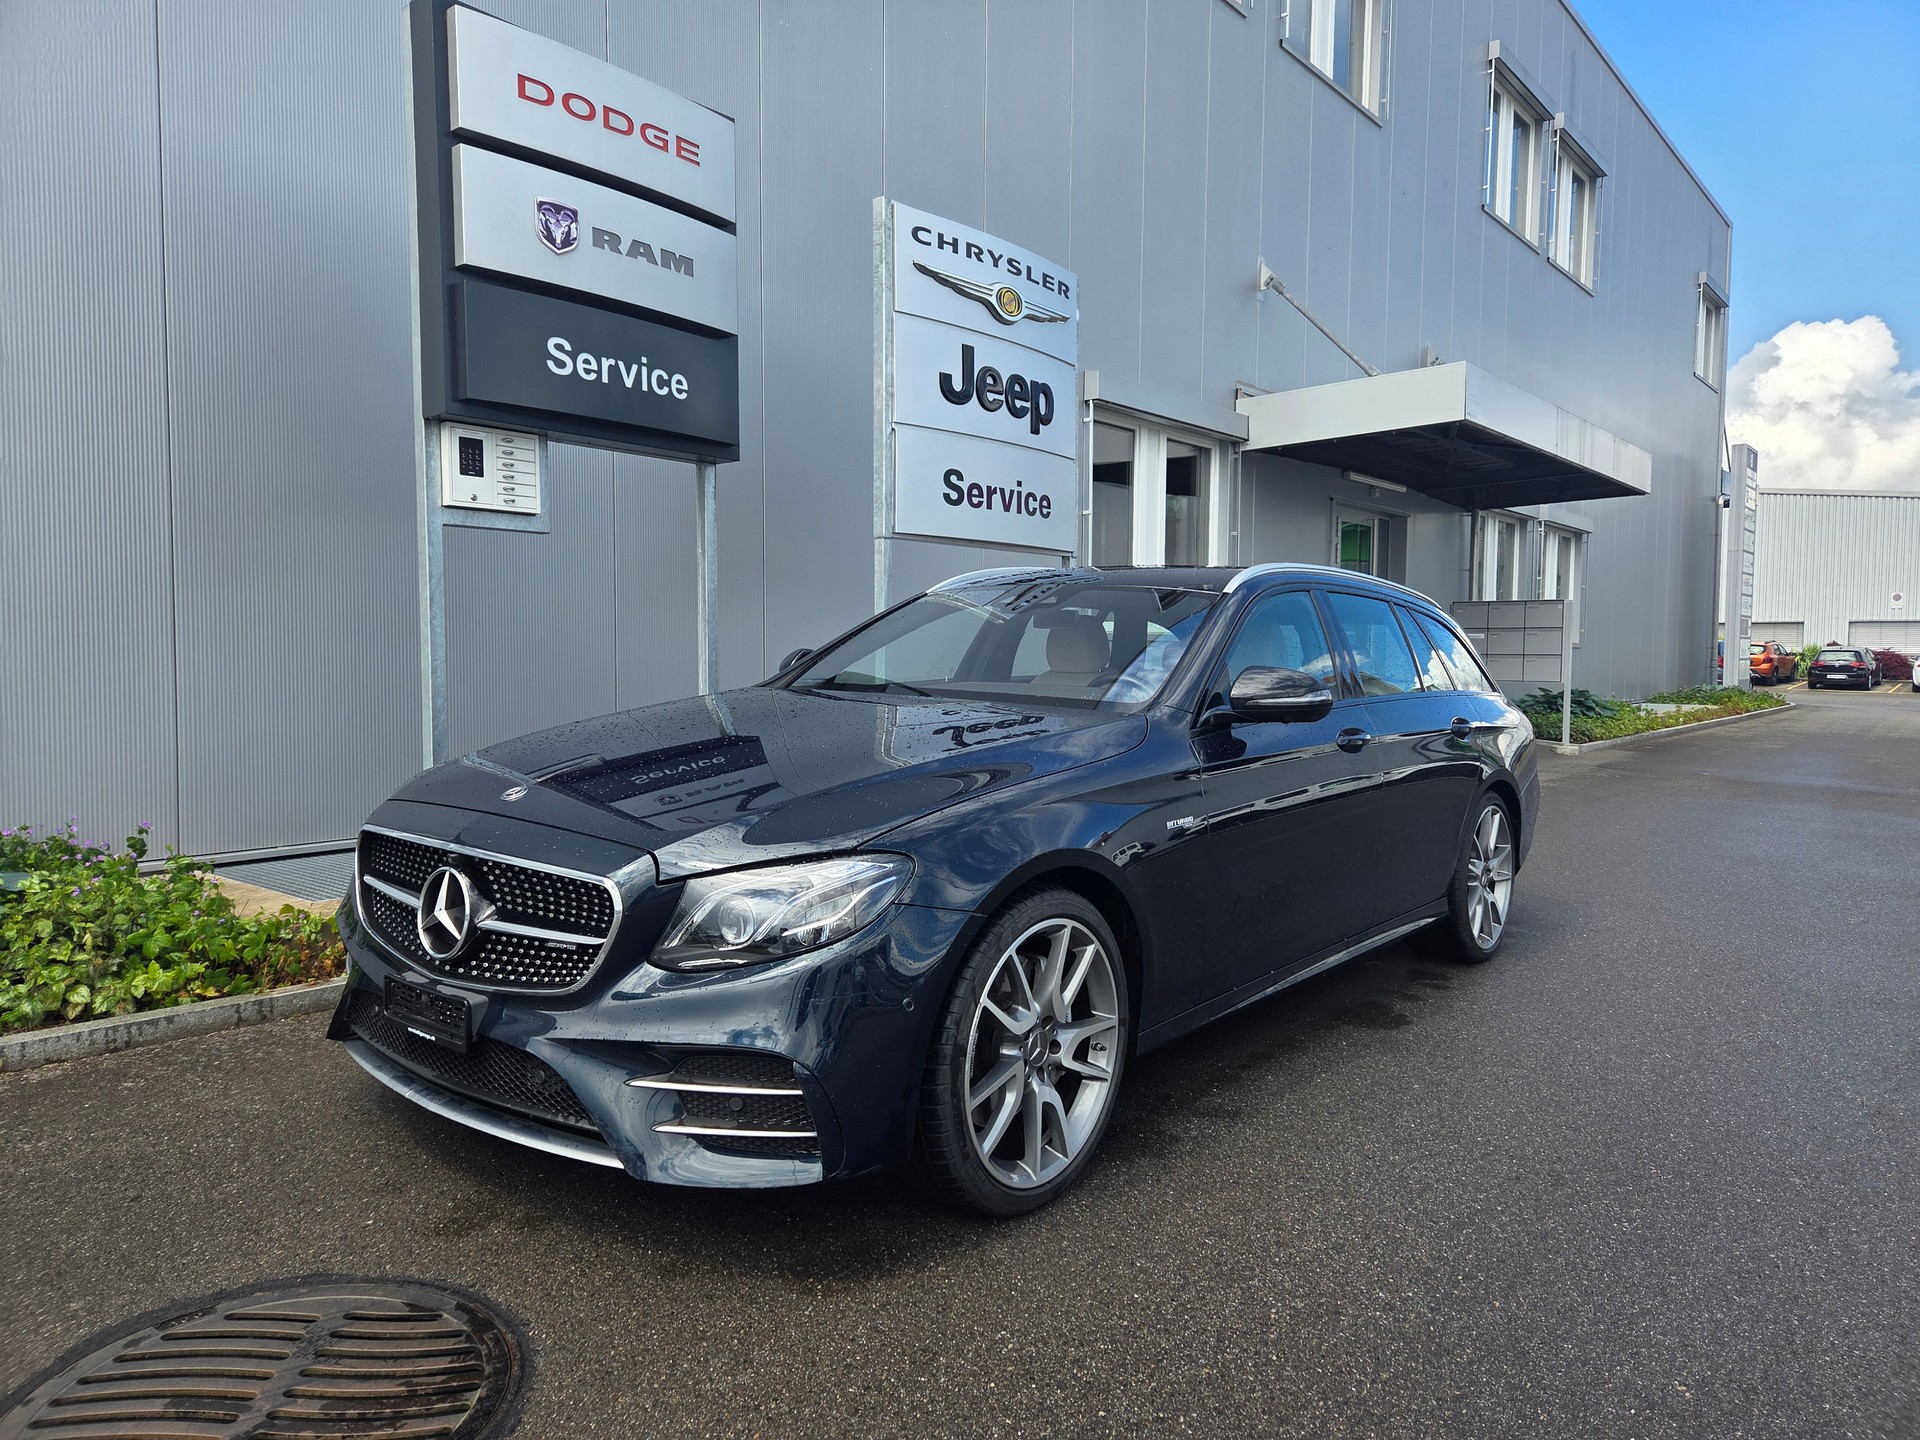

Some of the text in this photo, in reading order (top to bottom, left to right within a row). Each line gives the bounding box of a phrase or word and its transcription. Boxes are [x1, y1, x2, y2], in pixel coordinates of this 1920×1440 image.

[517, 73, 700, 166] DODGE
[592, 226, 694, 278] RAM
[911, 225, 1070, 299] CHRYSLER
[546, 336, 688, 400] Service
[939, 343, 1054, 435] Jeep
[942, 468, 1051, 519] Service
